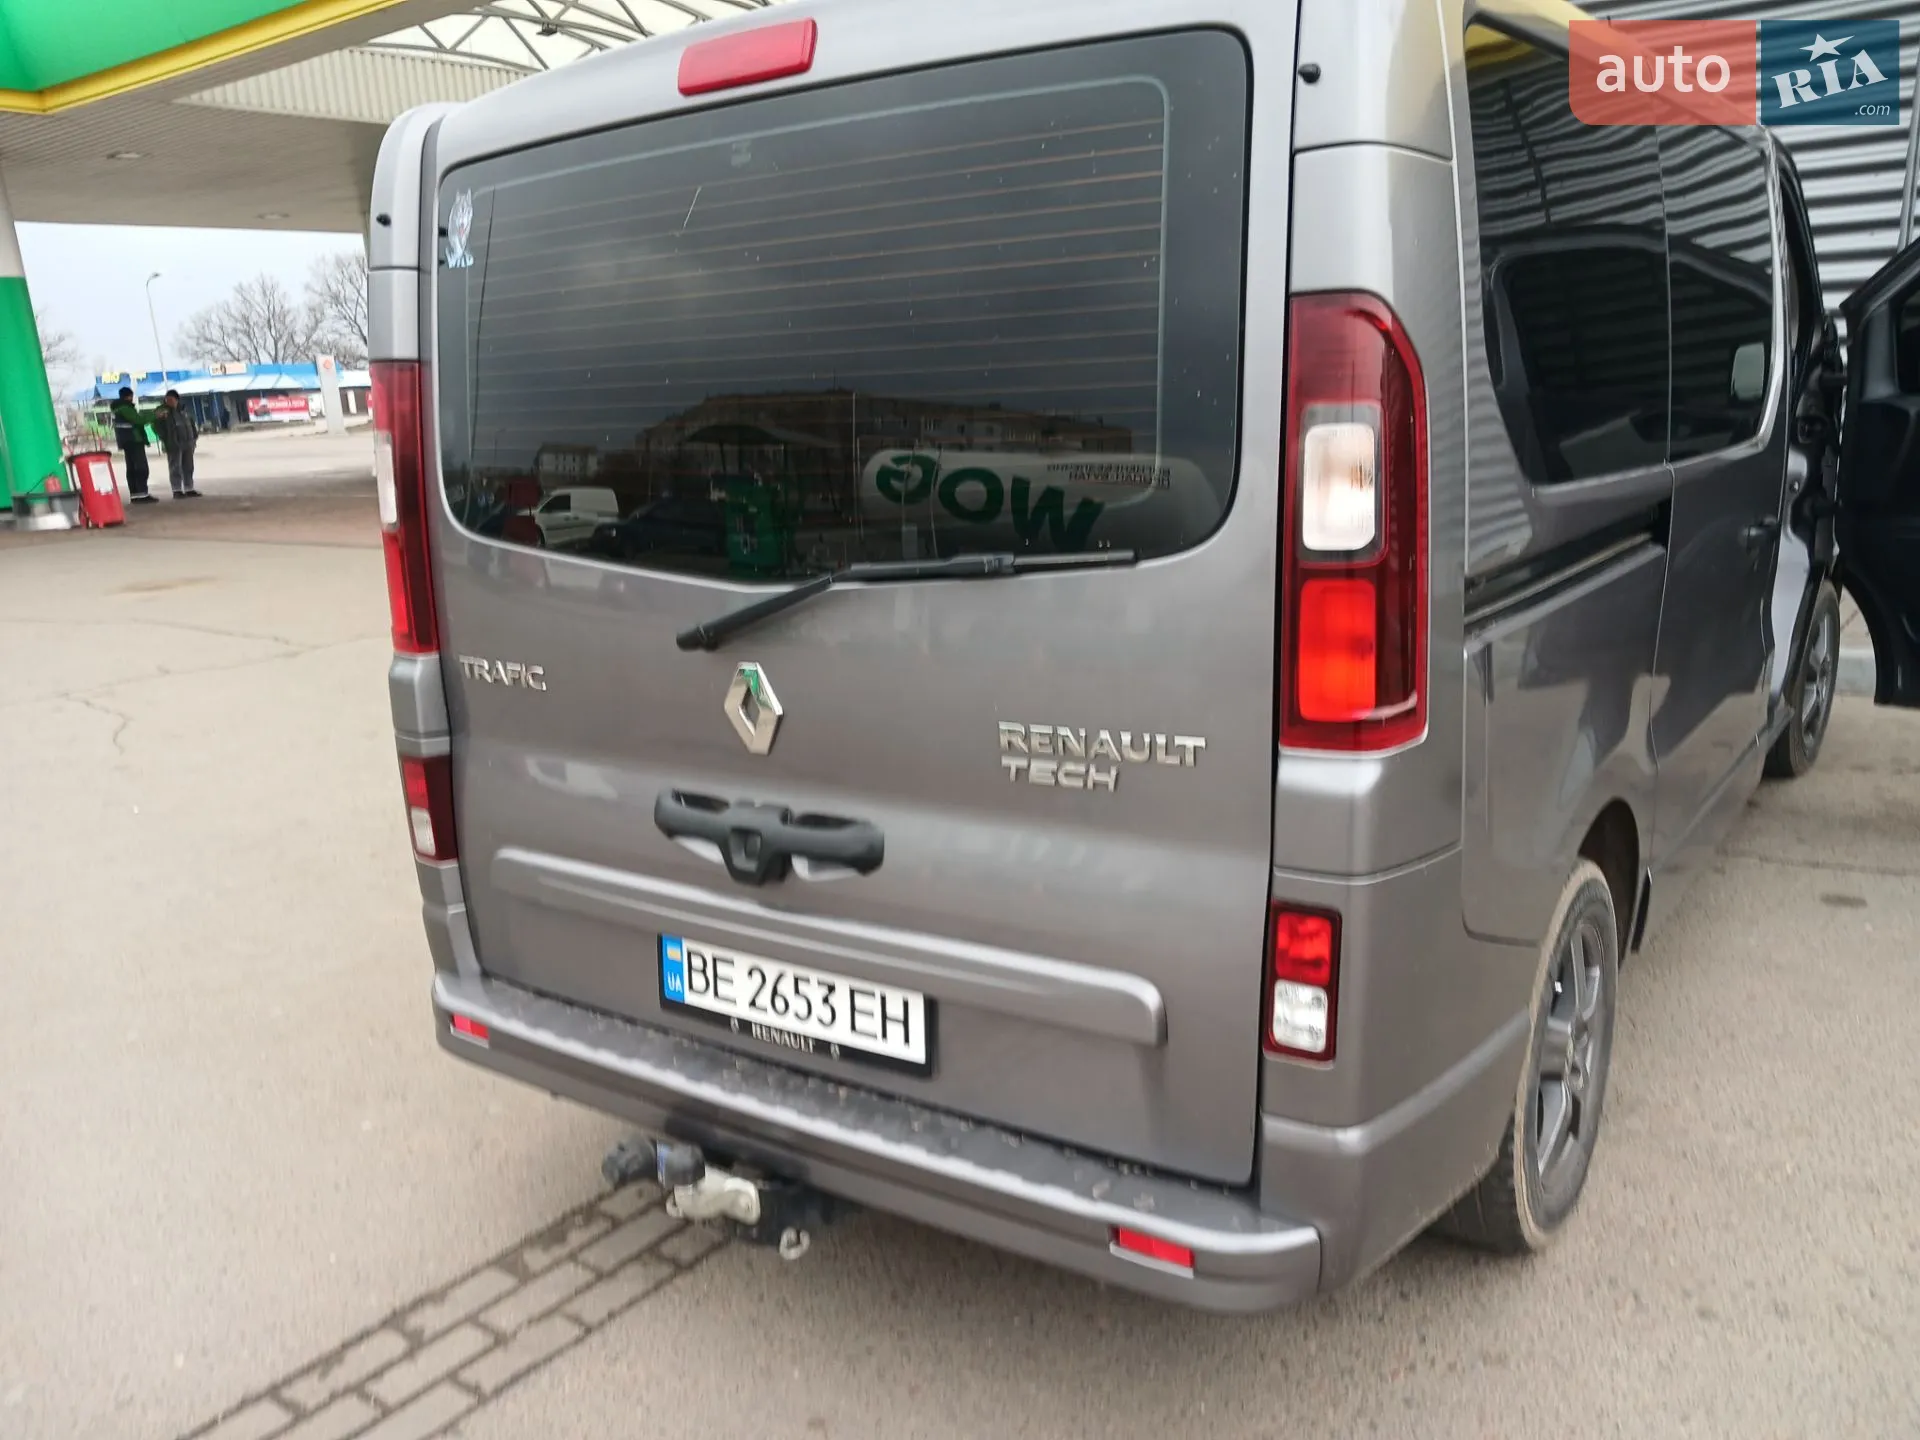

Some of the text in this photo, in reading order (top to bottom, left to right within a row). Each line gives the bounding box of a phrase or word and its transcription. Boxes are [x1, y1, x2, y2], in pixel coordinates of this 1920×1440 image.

[458, 655, 547, 691] TRAFIC
[998, 721, 1206, 767] RENAULT
[1001, 755, 1119, 792] TECH
[667, 971, 683, 993] UA
[686, 949, 911, 1049] BE 2653 EH
[751, 1022, 815, 1053] RENAULT
